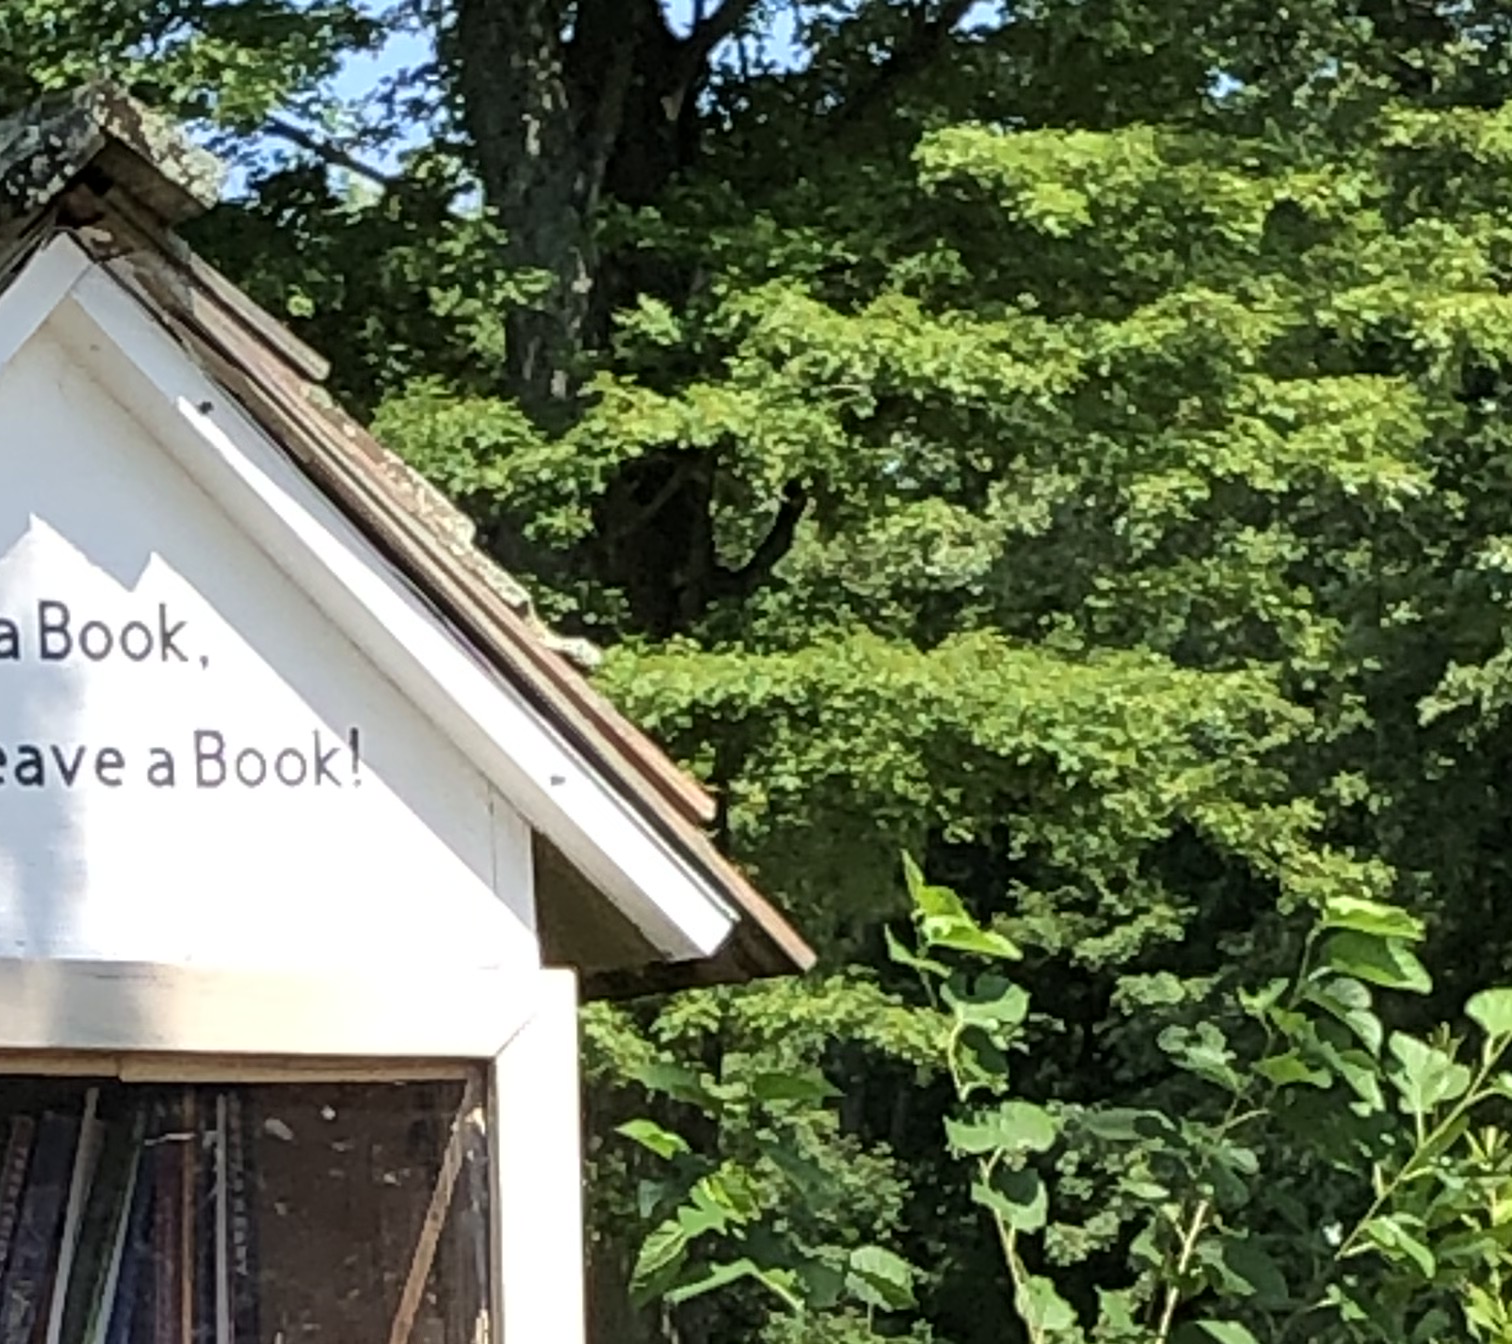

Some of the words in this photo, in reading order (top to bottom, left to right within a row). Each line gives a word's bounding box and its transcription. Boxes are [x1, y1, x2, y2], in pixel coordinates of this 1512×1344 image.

[37, 599, 210, 669] Book,
[147, 745, 176, 788] a
[193, 728, 363, 788] Book!
